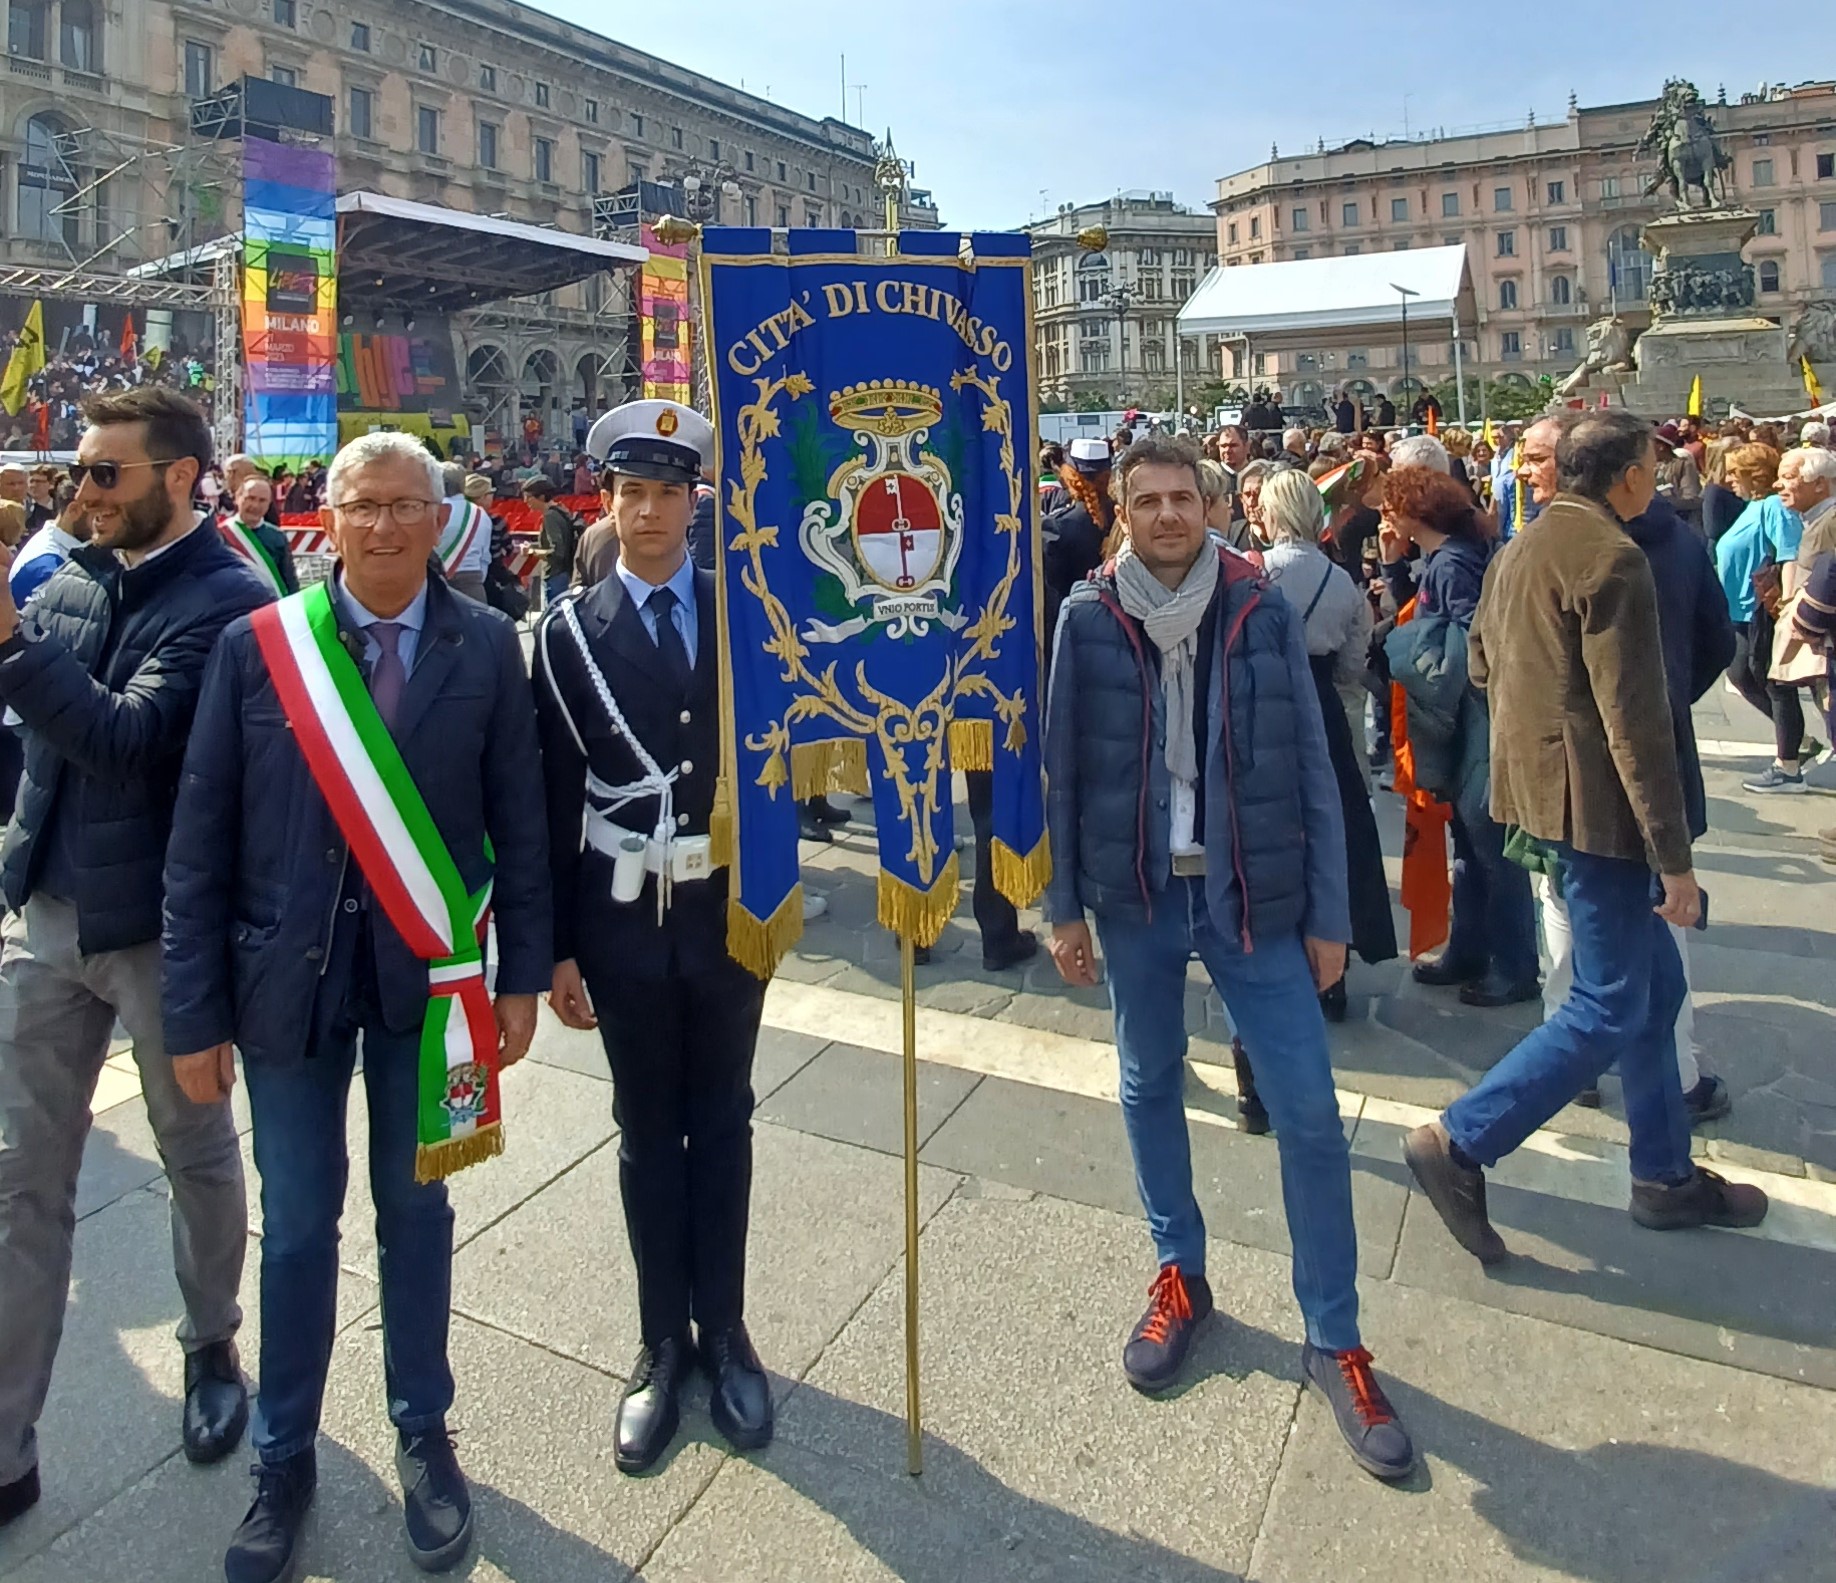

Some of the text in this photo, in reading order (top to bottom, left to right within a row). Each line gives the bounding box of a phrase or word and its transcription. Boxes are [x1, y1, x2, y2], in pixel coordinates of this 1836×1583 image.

[264, 314, 320, 334] MILANO
[821, 281, 871, 318] DI
[875, 280, 1012, 372] CHIVASSO
